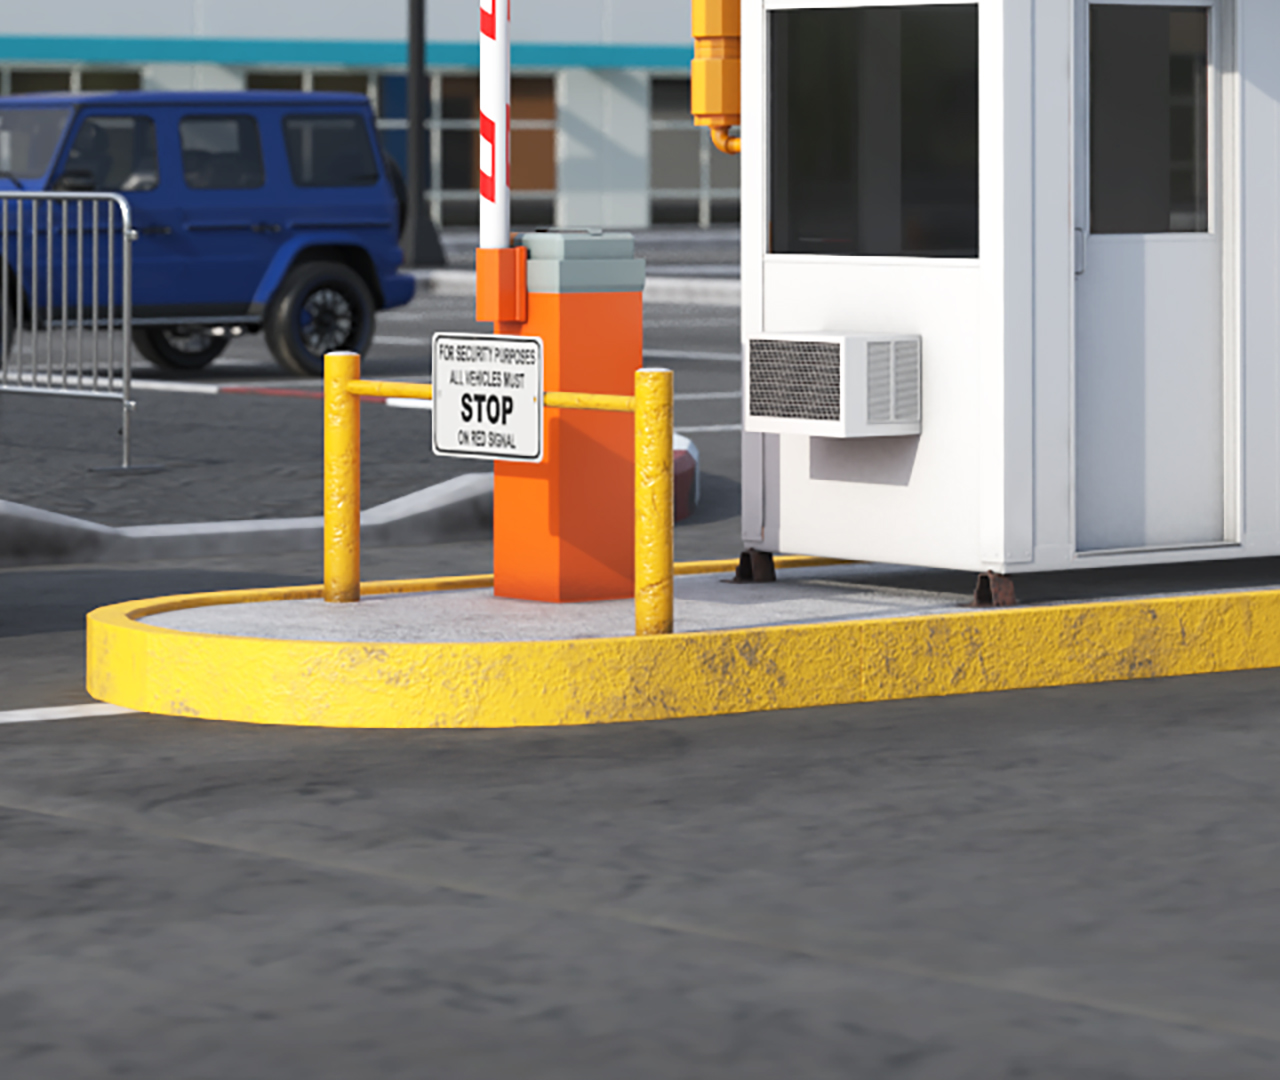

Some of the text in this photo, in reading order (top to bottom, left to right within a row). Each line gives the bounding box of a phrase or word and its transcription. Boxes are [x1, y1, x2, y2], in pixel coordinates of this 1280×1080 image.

[439, 343, 536, 366] FOR SECURITY PURPOSES
[449, 369, 525, 389] ALL VEHICLES MUST
[461, 393, 513, 425] STOP
[457, 429, 517, 450] ON RED SIGNAL
